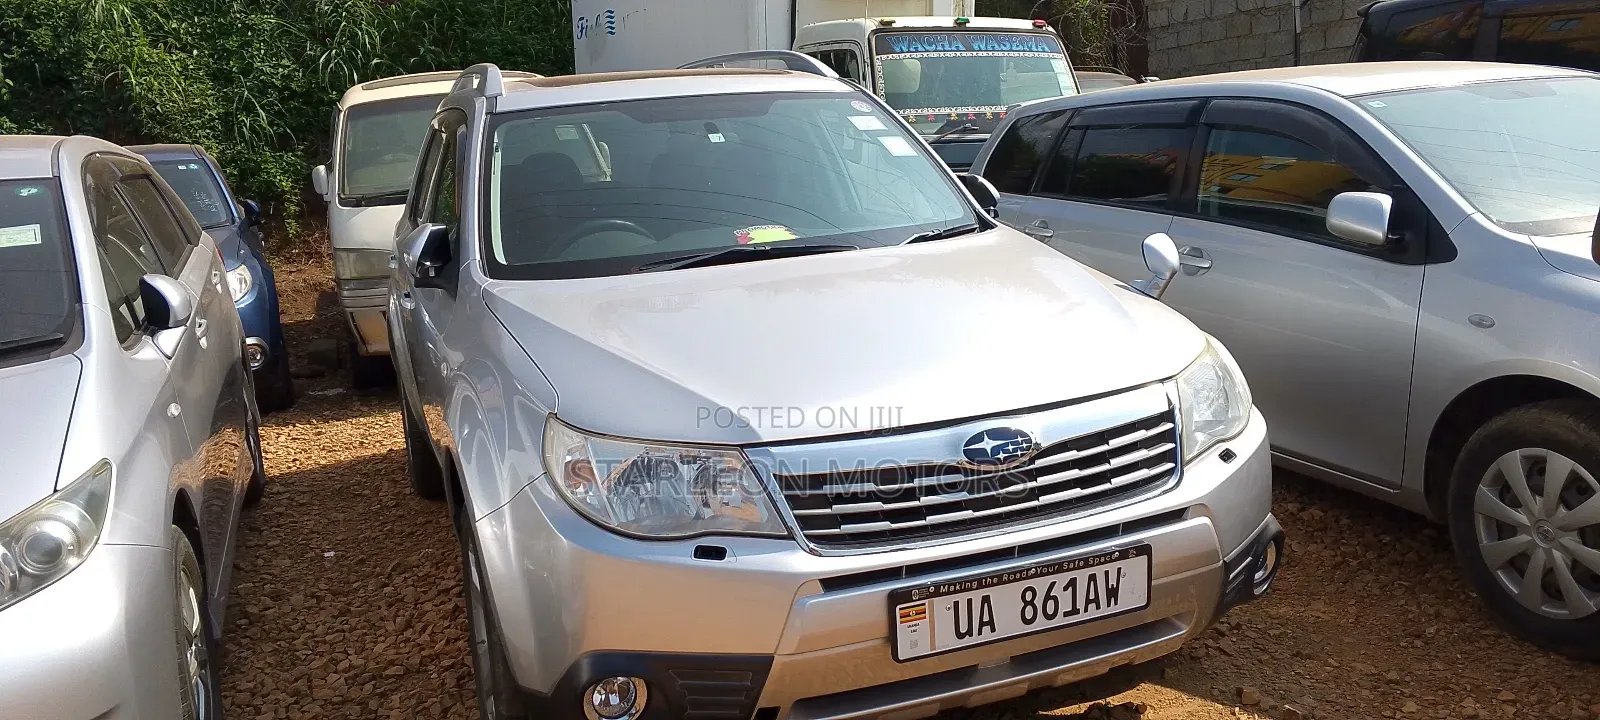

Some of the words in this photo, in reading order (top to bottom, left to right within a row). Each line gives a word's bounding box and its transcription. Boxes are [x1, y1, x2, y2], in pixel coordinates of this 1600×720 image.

[886, 34, 966, 53] WACHA
[965, 34, 1050, 53] WASEMA
[940, 580, 978, 593] Making
[982, 576, 998, 586] the
[1002, 570, 1032, 582] Roads
[1036, 564, 1059, 575] Your
[1063, 560, 1084, 570] Safe
[1088, 553, 1116, 566] Space
[953, 594, 997, 640] UA
[1020, 566, 1122, 626] 861AW
